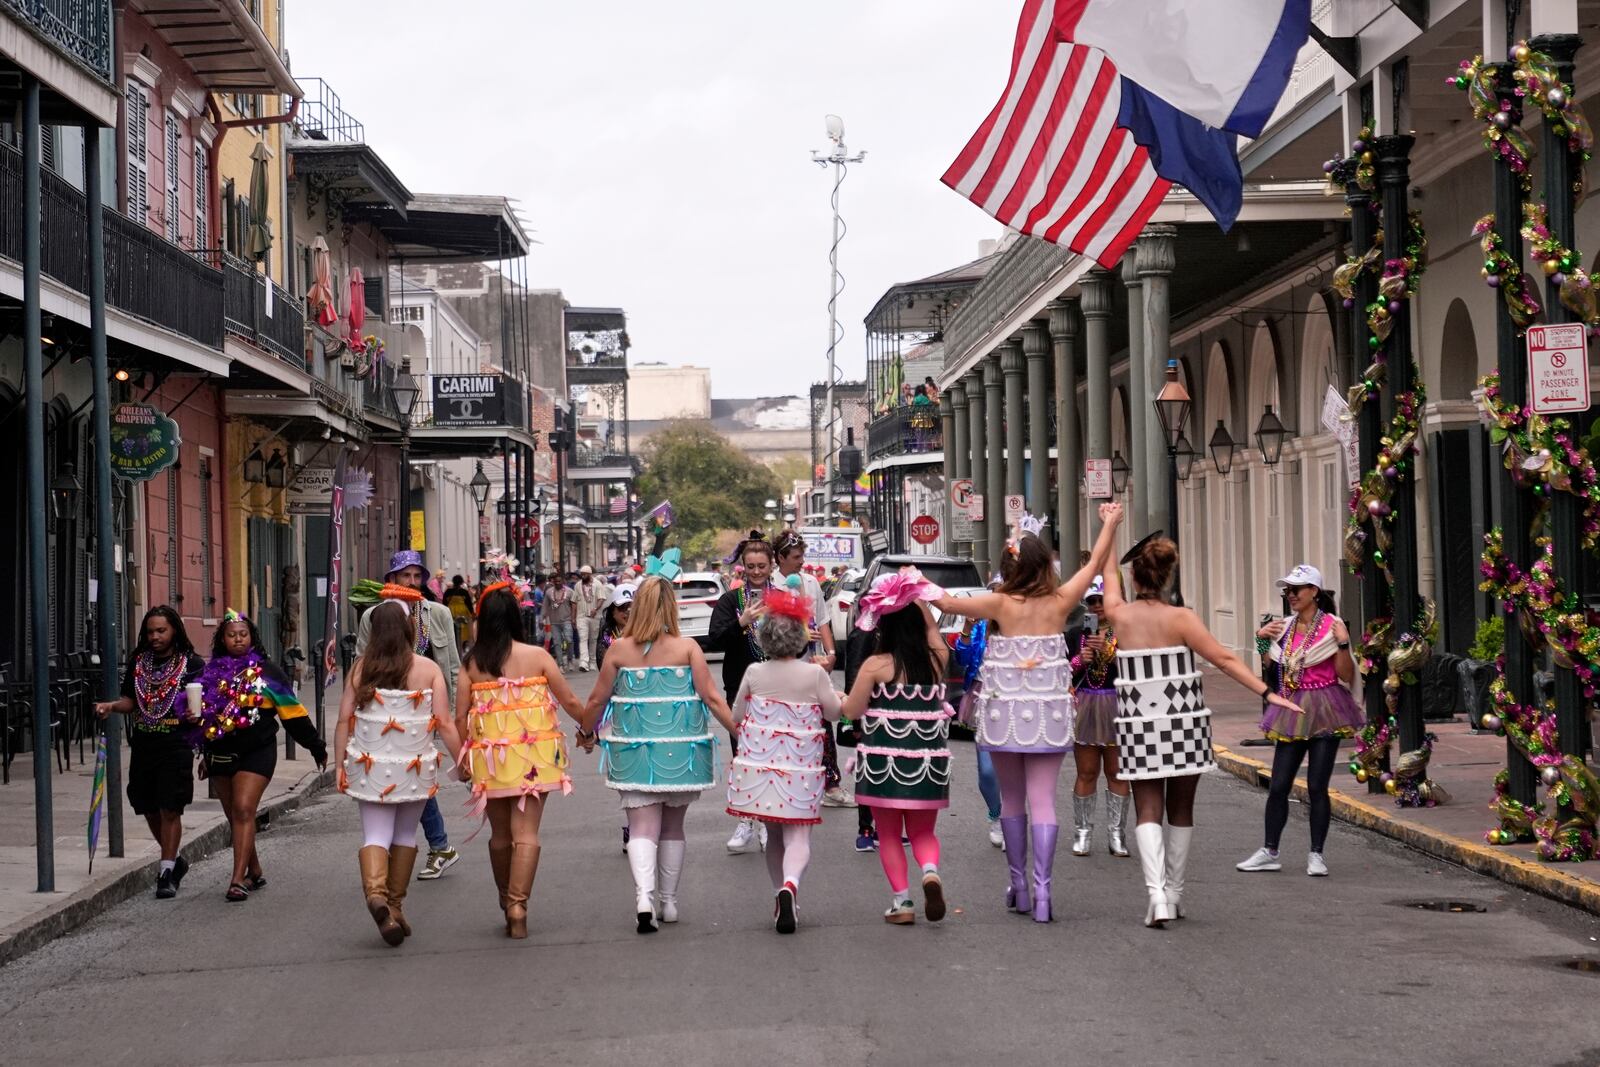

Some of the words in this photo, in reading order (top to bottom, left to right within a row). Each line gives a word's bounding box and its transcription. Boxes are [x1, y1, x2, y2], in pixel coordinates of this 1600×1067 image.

[1531, 330, 1544, 348] NO
[1552, 368, 1574, 377] MINUTE
[439, 377, 494, 393] CARIMI
[1541, 378, 1579, 388] PASSENGER
[1550, 390, 1569, 398] ZONE
[120, 406, 152, 415] ORLEANS
[116, 416, 156, 424] GRAPEVINE
[118, 458, 132, 466] BAR
[135, 458, 141, 467] &
[143, 448, 166, 465] BISTRO
[296, 476, 329, 484] CIGAR
[912, 524, 938, 536] STOP
[804, 538, 838, 554] FOX
[838, 539, 852, 554] 8
